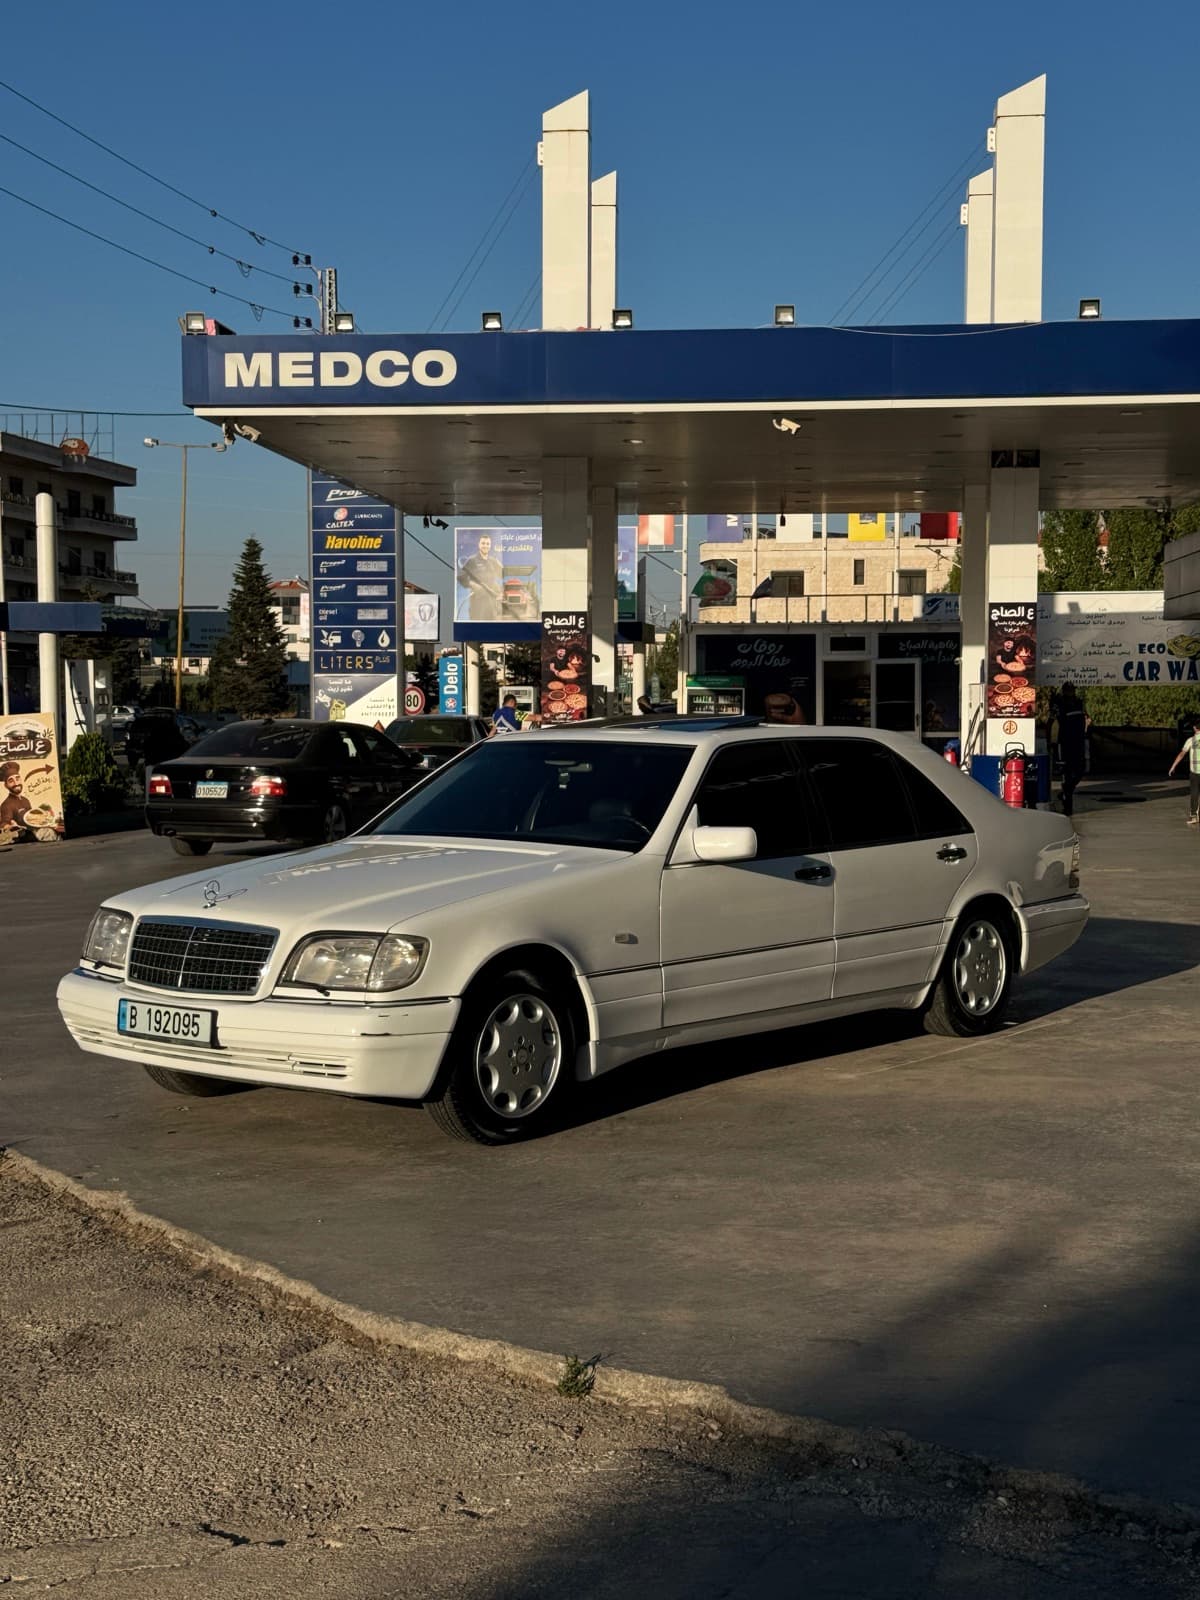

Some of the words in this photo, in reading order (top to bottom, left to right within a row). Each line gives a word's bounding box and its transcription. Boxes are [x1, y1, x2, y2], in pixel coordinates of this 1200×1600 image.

[224, 350, 457, 387] MEDCO
[325, 520, 355, 529] CALTEX
[325, 535, 382, 549] Havoline
[991, 606, 1025, 620] الصاج
[1027, 608, 1035, 620] ع
[543, 615, 576, 629] الصاج
[578, 617, 585, 629] ع
[320, 656, 374, 669] LITERS
[1123, 661, 1160, 681] CAR
[443, 664, 459, 695] Delo
[406, 695, 419, 707] 80
[0, 737, 34, 756] الصاج
[35, 740, 46, 755] ع
[129, 1005, 138, 1029] B
[147, 1007, 201, 1037] 192095
